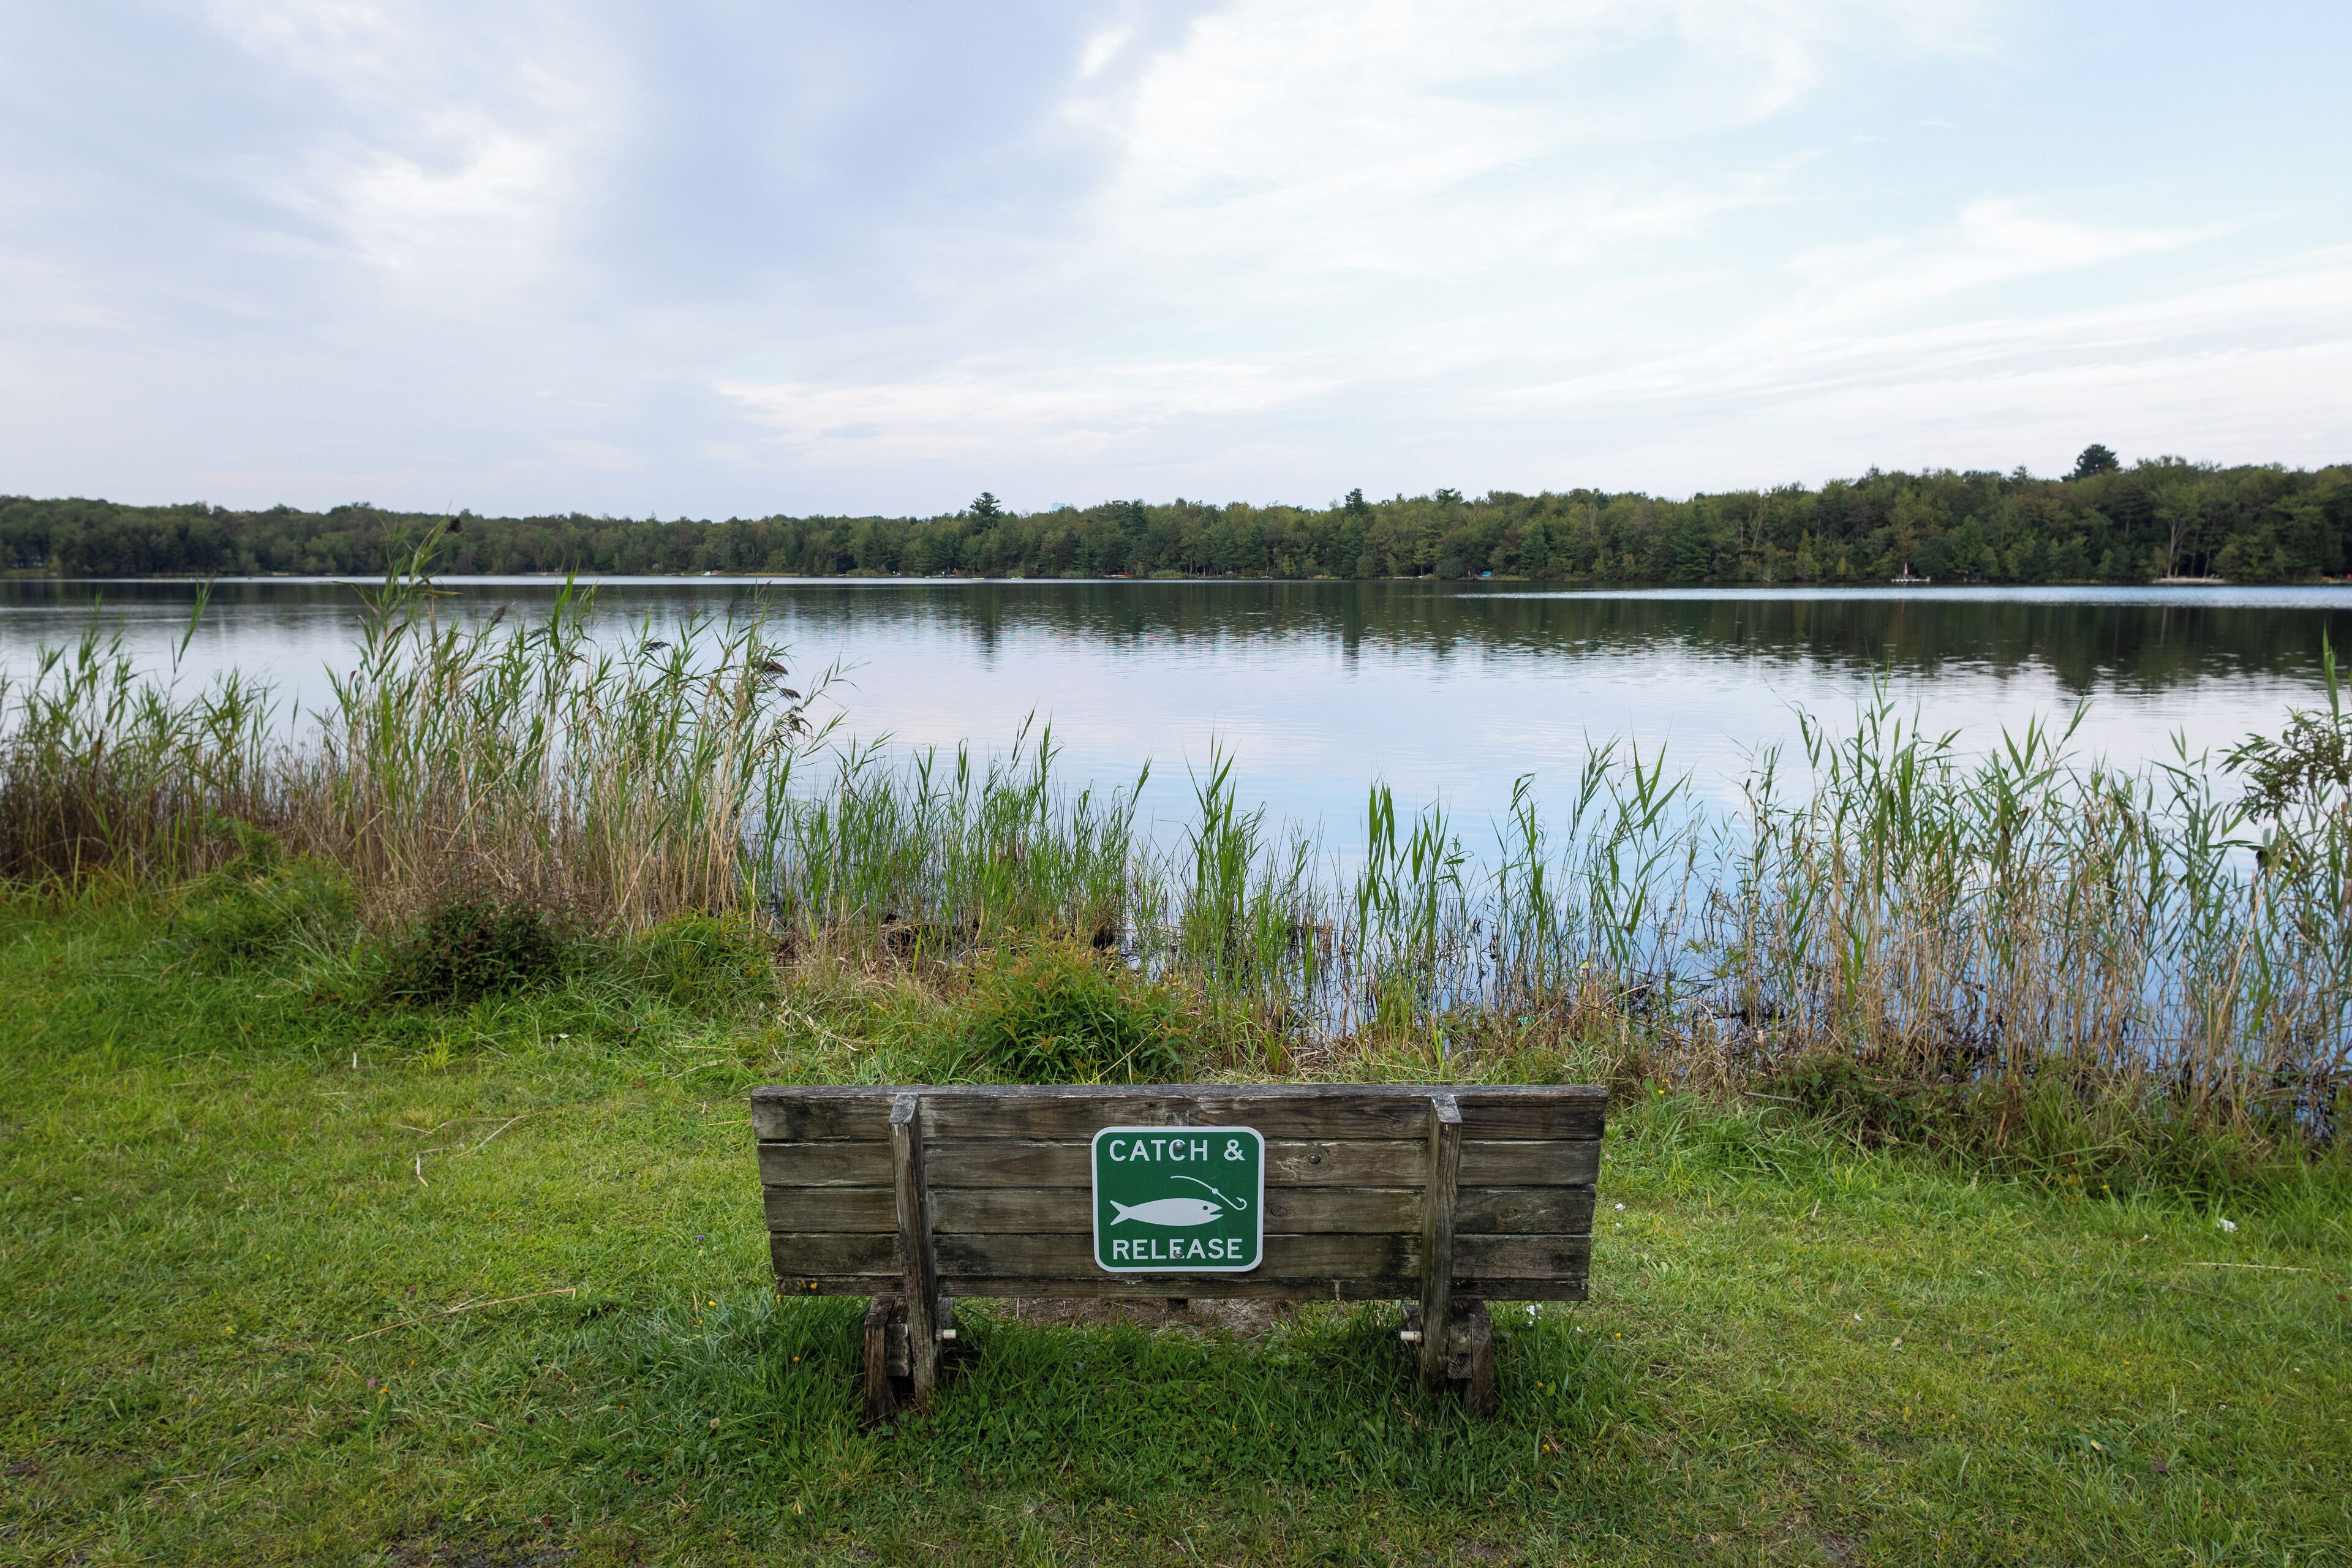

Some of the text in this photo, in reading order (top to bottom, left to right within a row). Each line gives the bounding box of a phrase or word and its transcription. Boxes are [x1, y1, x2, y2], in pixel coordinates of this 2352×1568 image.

[1109, 1139, 1245, 1161] CATCH &
[1112, 1238, 1243, 1260] RELEASE
